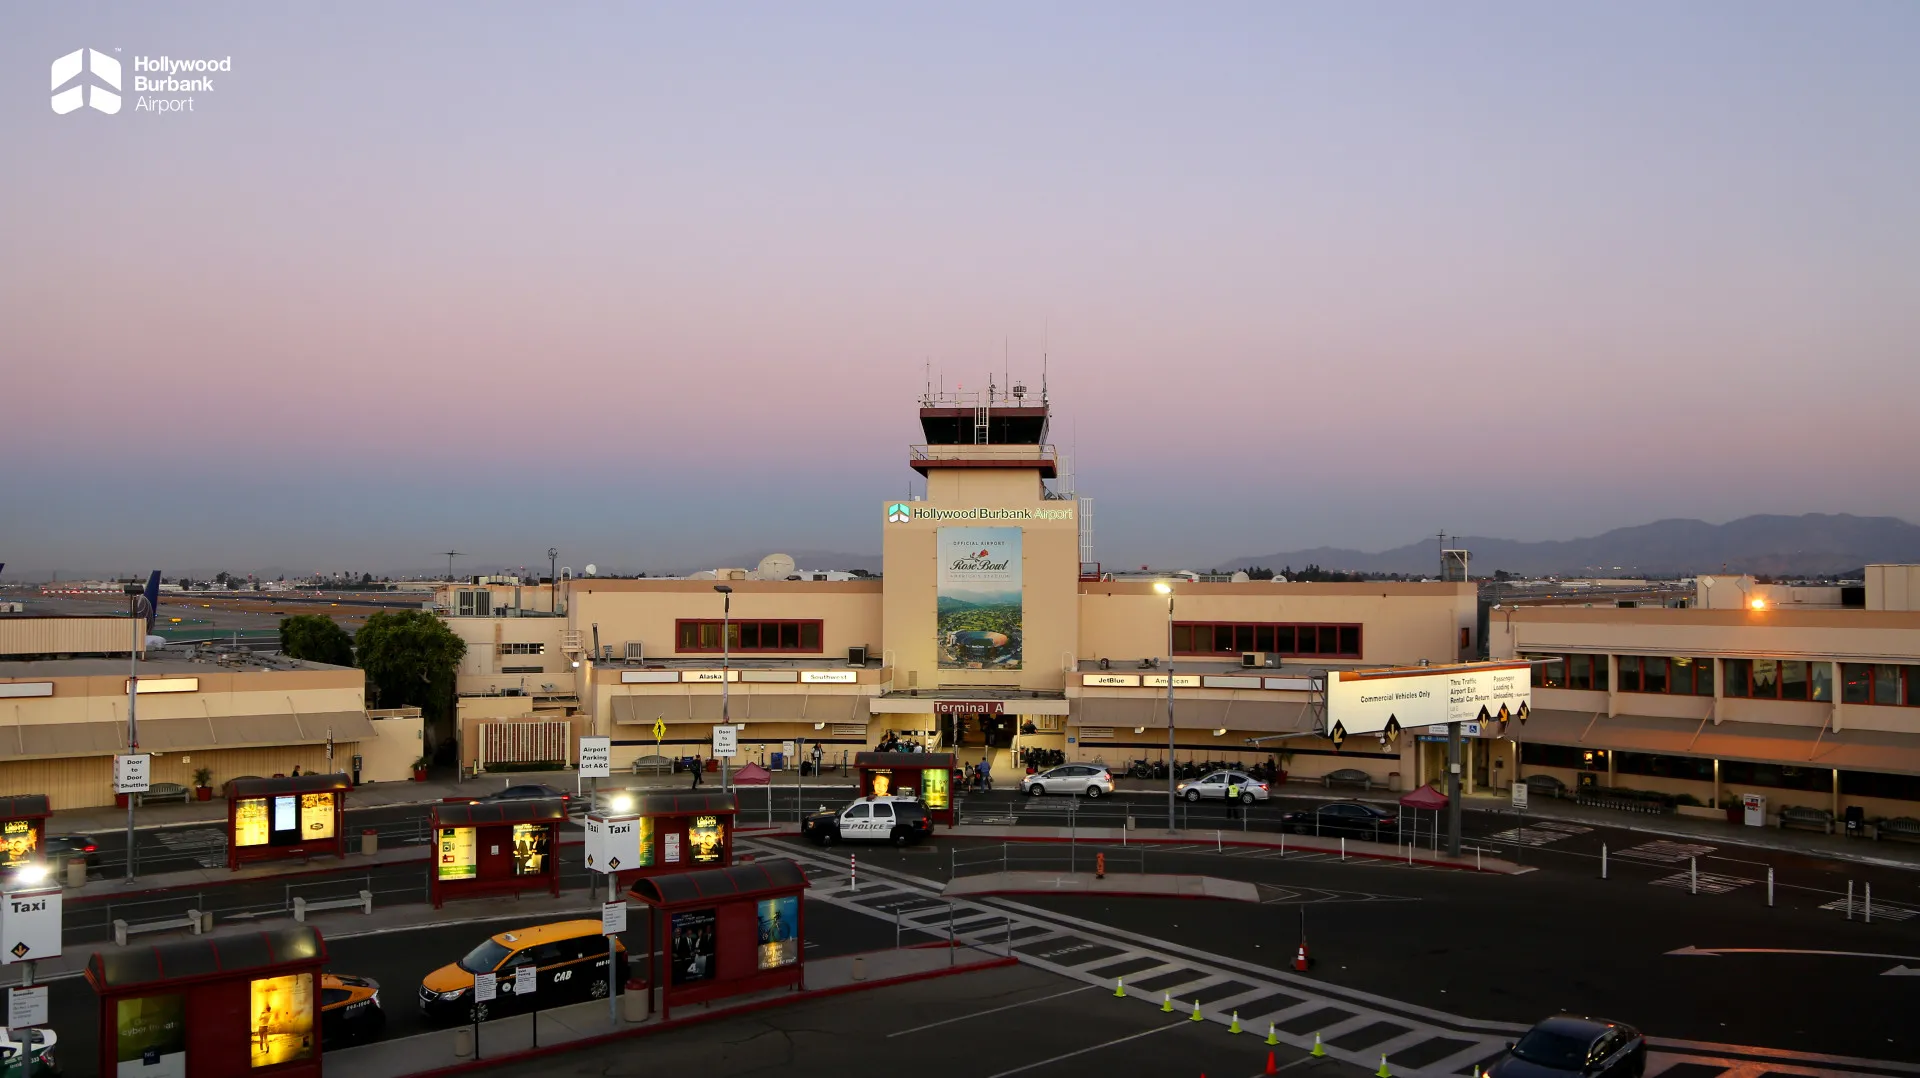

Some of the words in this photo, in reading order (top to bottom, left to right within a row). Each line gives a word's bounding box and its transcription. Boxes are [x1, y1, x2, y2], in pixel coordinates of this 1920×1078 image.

[914, 508, 977, 521] Hollywood
[979, 508, 1032, 520] Burbank
[1033, 508, 1073, 522] Airport
[950, 559, 978, 571] Rose
[977, 559, 1009, 571] Bowl
[1462, 677, 1477, 685] Traffic
[1360, 693, 1393, 703] Commercial
[1395, 691, 1418, 700] Vehicles
[1418, 690, 1431, 699] Only
[1450, 687, 1467, 696] Airport
[1467, 686, 1476, 694] Exit
[1450, 696, 1465, 704] Rental
[1465, 694, 1474, 702] Car
[1474, 693, 1490, 702] Return
[934, 702, 989, 713] Terminal
[994, 703, 1004, 713] A
[587, 821, 599, 834] Taxi
[608, 823, 631, 834] Taxi
[11, 899, 46, 914] Taxi
[554, 970, 573, 983] CAB
[122, 1026, 147, 1036] cyber
